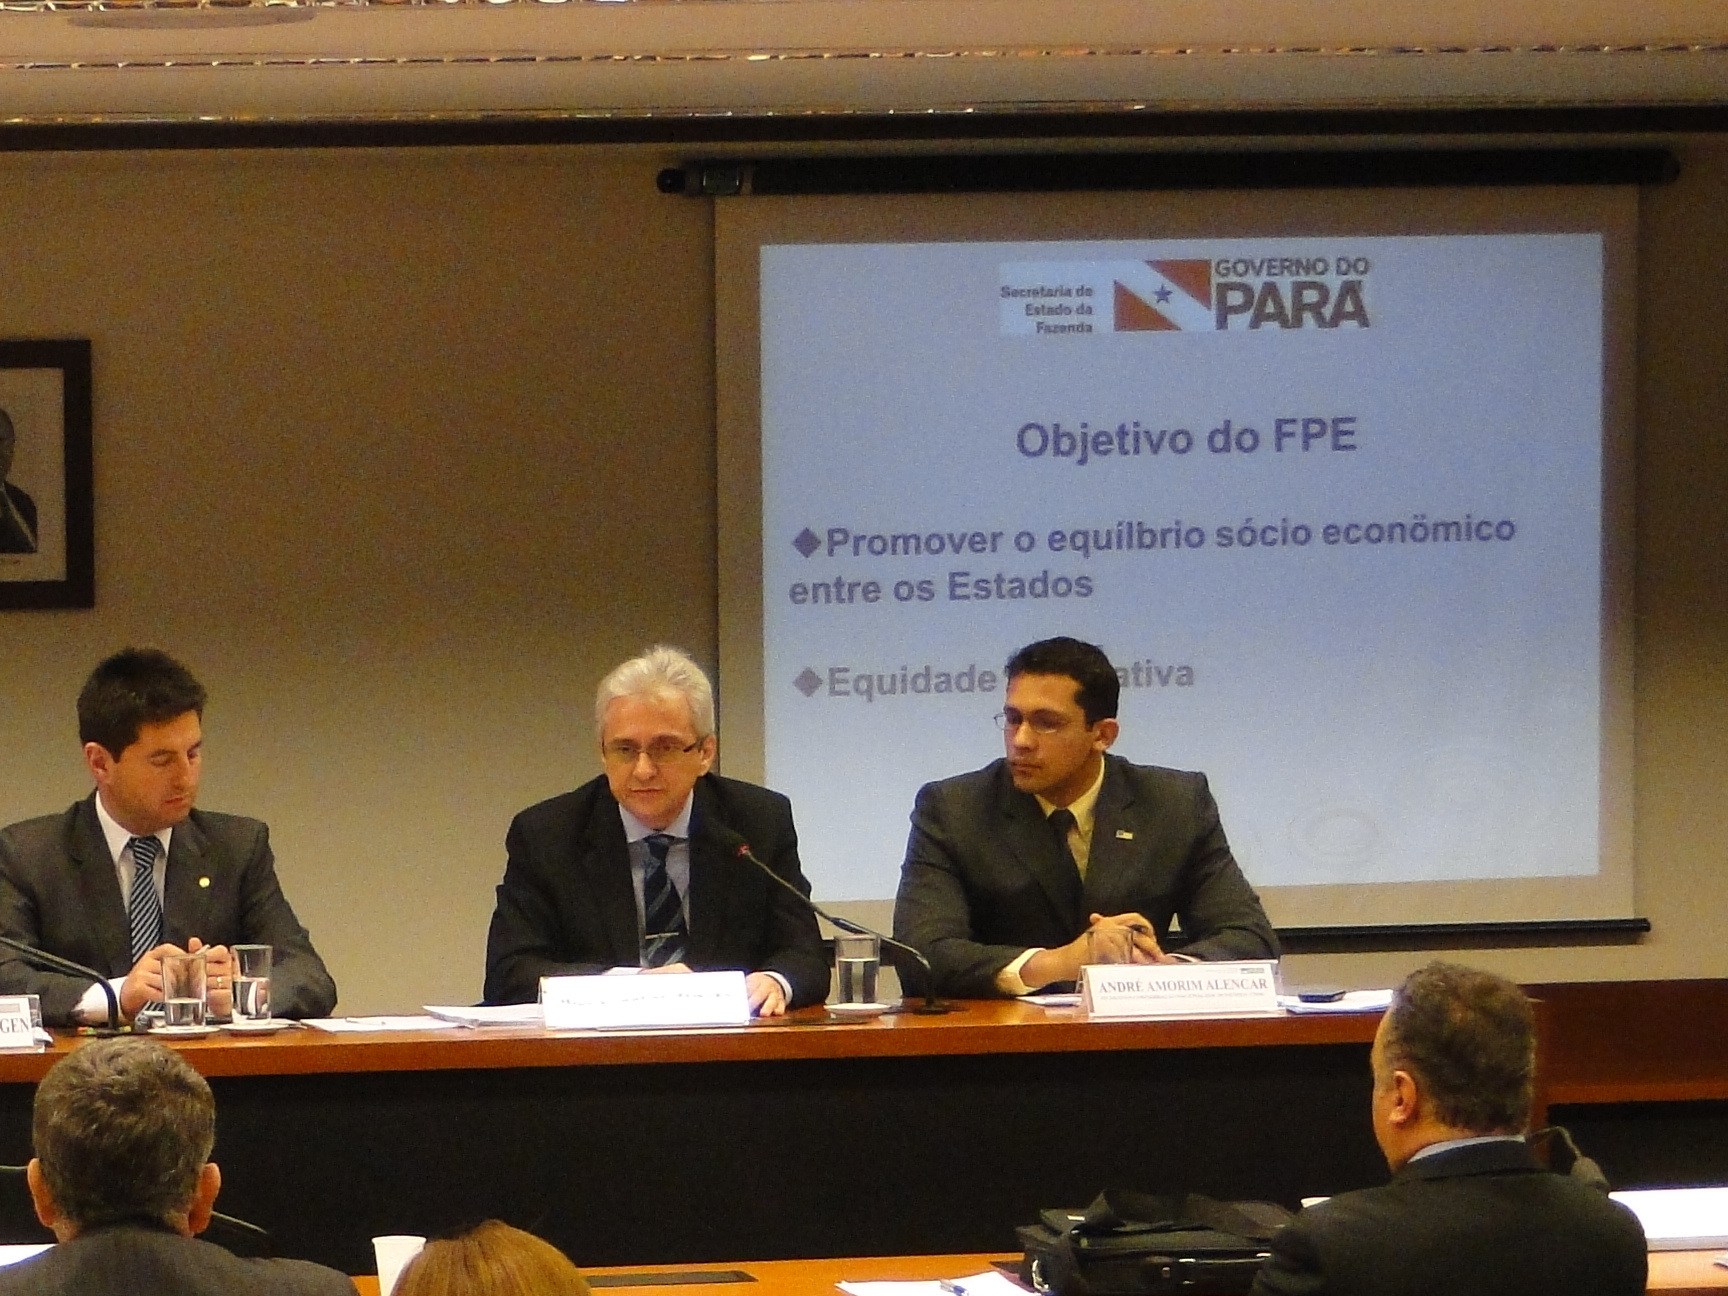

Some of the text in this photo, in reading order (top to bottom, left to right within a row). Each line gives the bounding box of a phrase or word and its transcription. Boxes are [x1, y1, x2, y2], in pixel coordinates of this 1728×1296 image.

[1215, 256, 1370, 278] GOVERNO DO
[1001, 285, 1093, 299] Secretaria de
[1025, 302, 1093, 317] Estado da
[1036, 321, 1093, 335] Fazenda
[1016, 416, 1358, 466] Objetivo do FPE
[826, 526, 1004, 558] Promover
[1014, 531, 1036, 554] o
[1215, 514, 1311, 550] sócio
[789, 570, 1095, 607] entre os Estados
[827, 659, 1195, 703] Equidade ativa
[1098, 977, 1269, 994] ANDRÉ AMORIM ALENCAR
